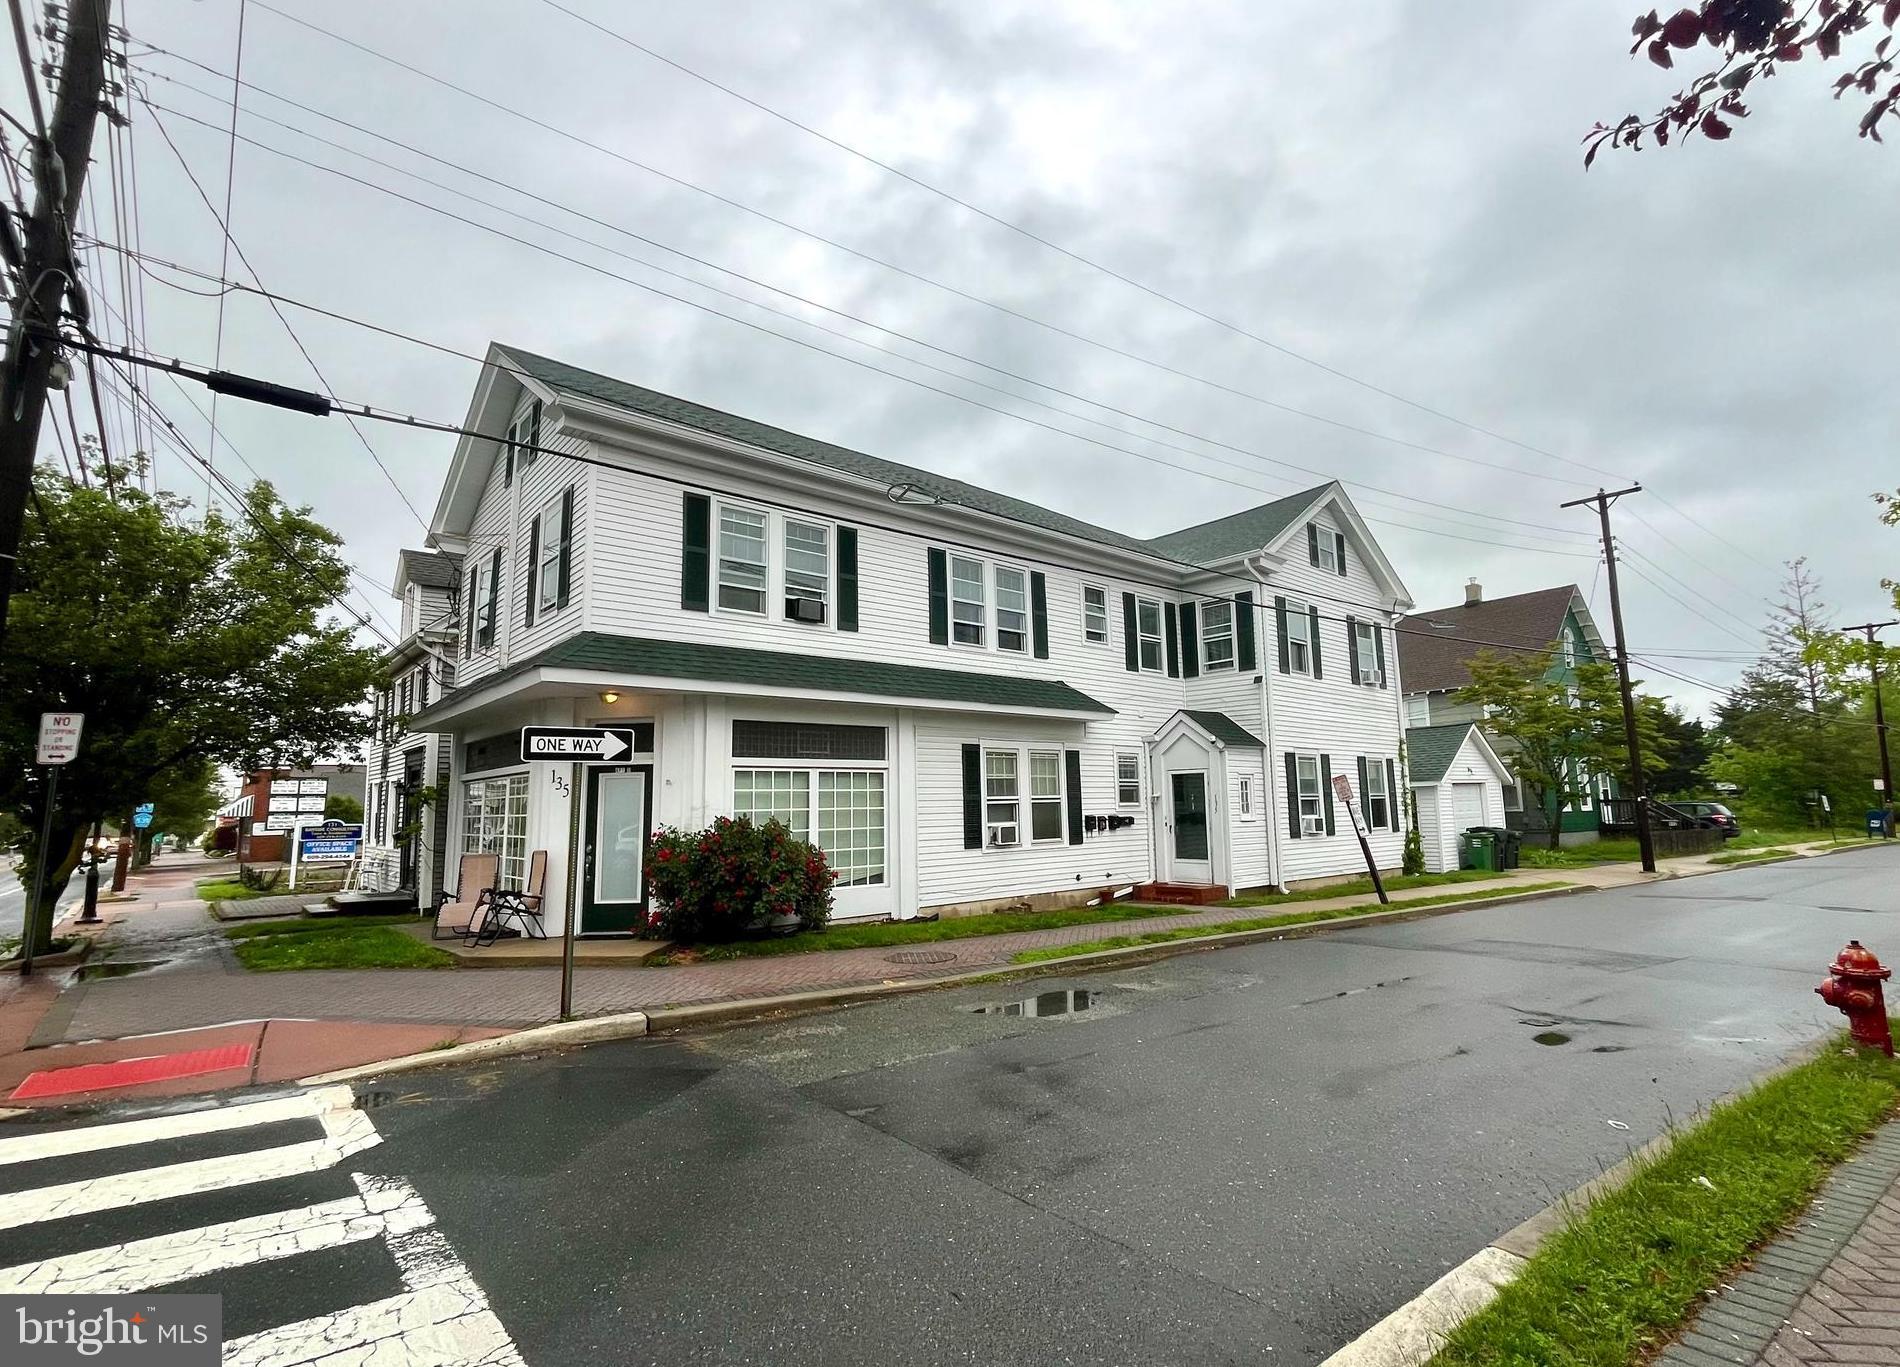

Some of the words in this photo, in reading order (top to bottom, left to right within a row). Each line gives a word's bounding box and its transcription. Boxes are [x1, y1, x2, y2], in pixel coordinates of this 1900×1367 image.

[53, 716, 71, 727] NO
[536, 738, 566, 751] ONE
[573, 739, 602, 752] WAY
[551, 769, 570, 798] 135
